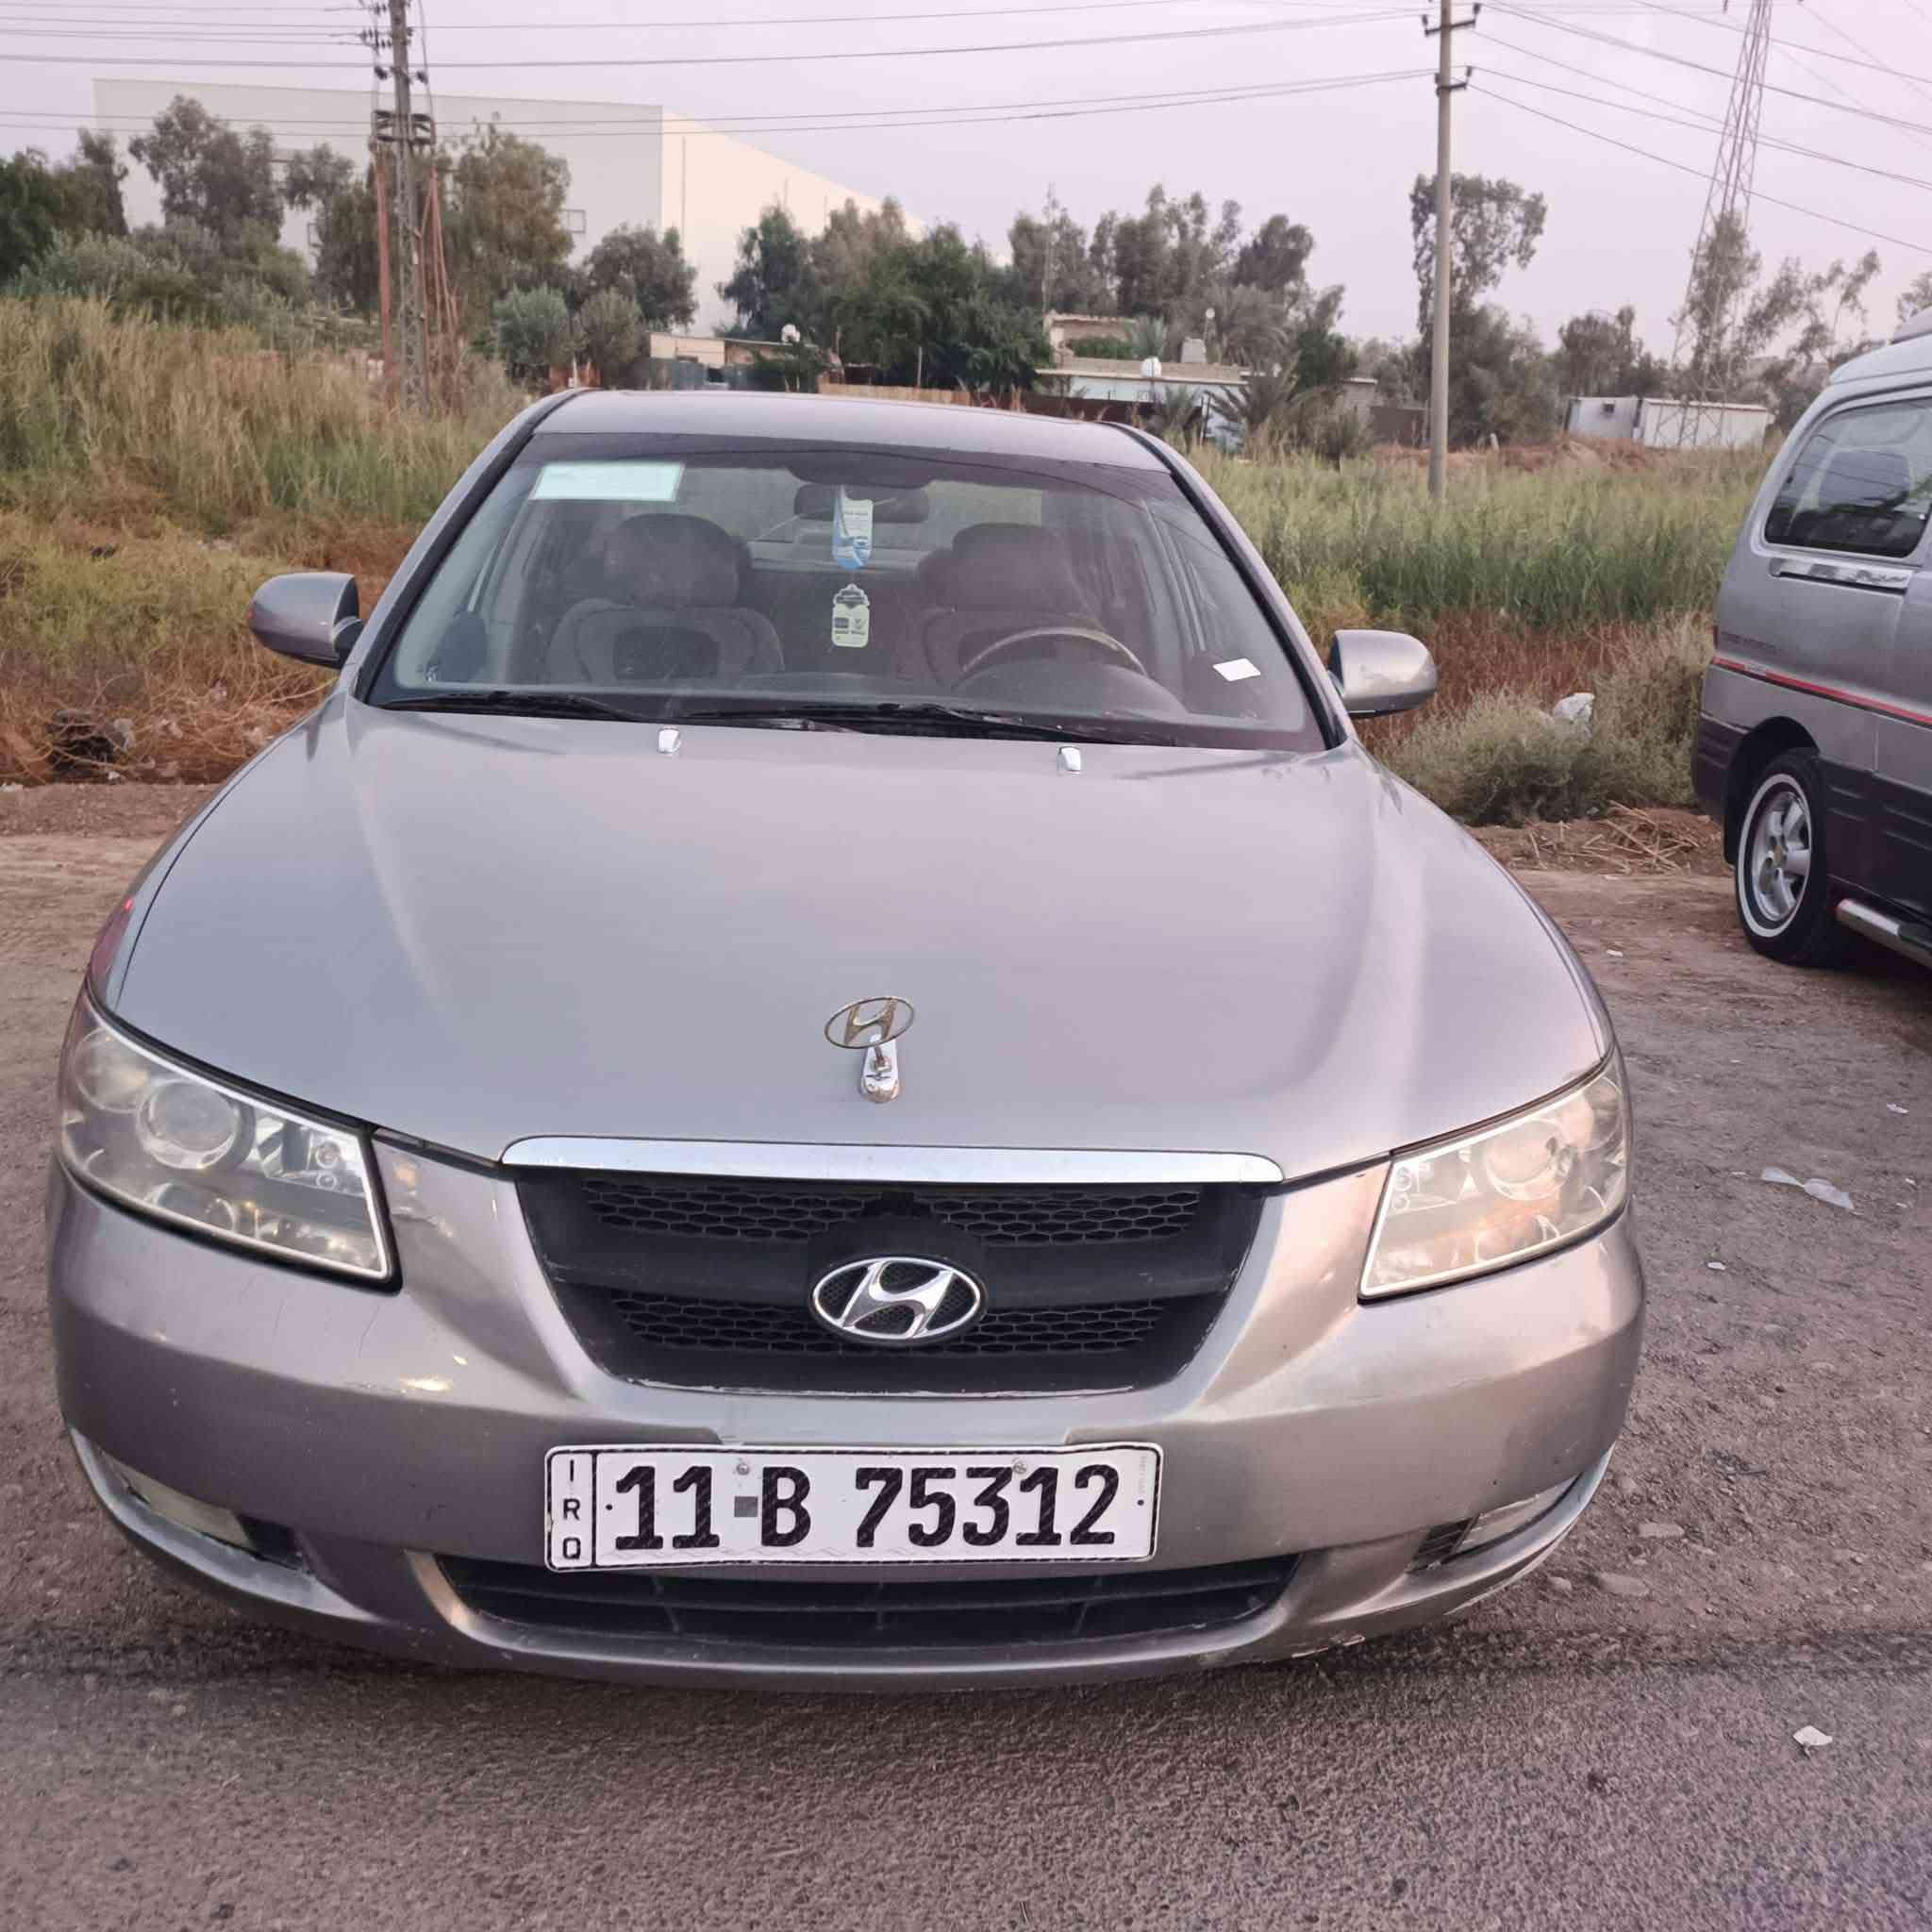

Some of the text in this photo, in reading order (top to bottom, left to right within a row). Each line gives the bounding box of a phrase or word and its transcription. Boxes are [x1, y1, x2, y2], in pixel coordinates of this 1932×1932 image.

[615, 1465, 721, 1551] 11
[760, 1466, 811, 1547] B
[855, 1464, 1120, 1548] 75312
